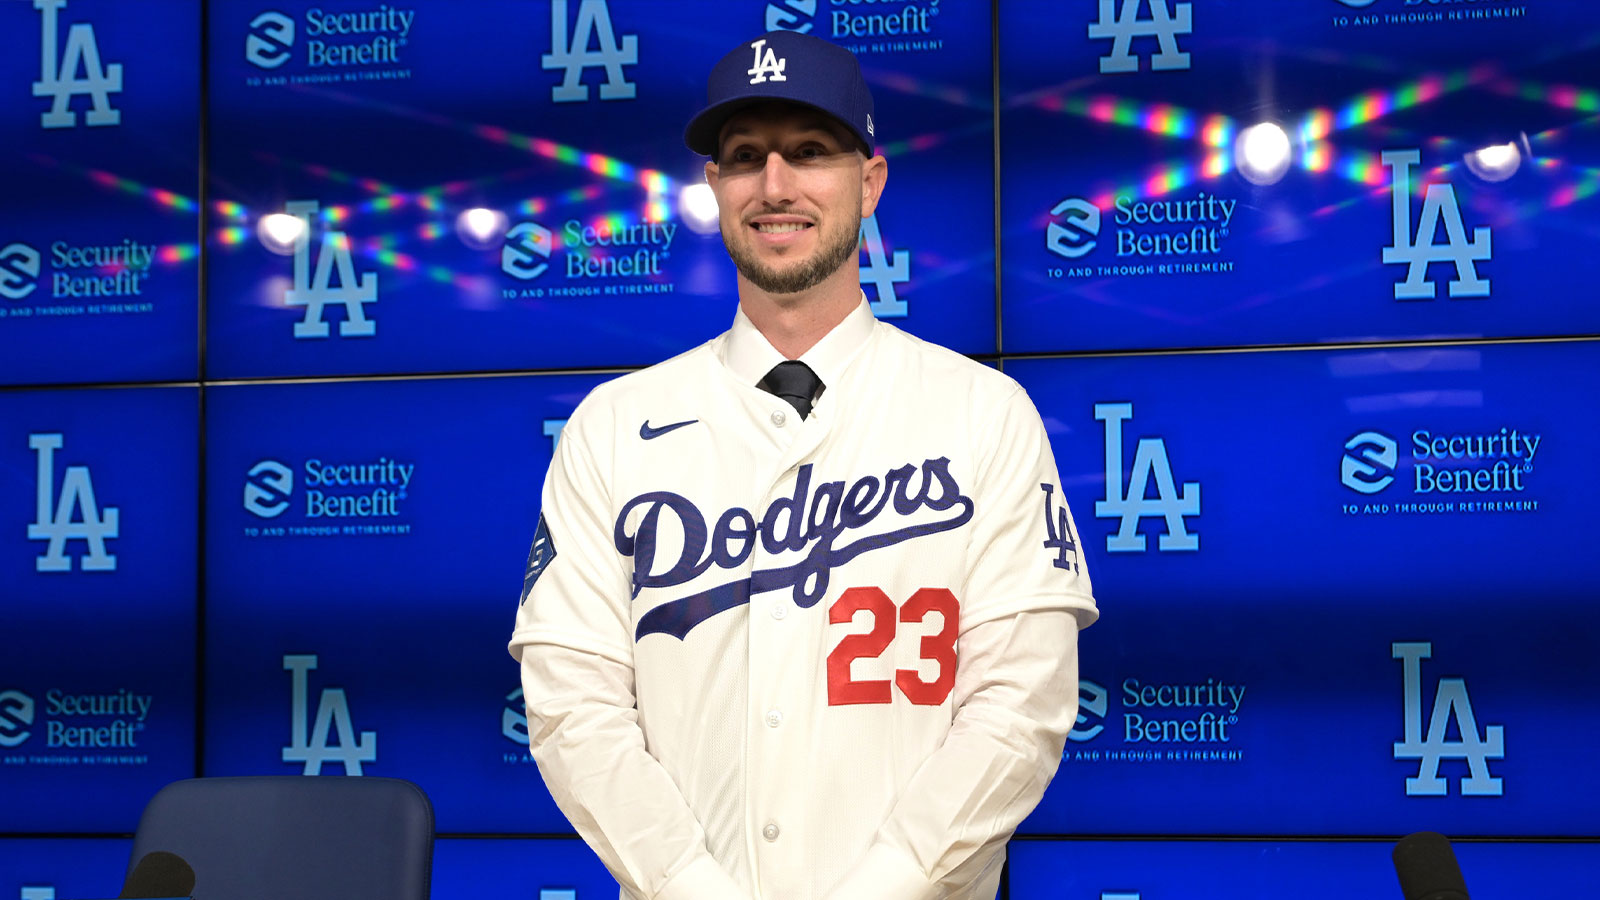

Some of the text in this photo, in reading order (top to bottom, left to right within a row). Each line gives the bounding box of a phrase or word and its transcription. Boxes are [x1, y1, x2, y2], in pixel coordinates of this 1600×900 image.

[306, 4, 414, 37] Security
[1333, 6, 1526, 27] TO AND THROUGH RETIREMENT
[32, 0, 123, 128] LA
[748, 39, 786, 85] LA
[1115, 192, 1237, 227] Security
[1381, 149, 1491, 299] LA
[564, 217, 677, 250] Security
[51, 238, 157, 271] Security
[285, 201, 378, 338] LA
[1048, 262, 1234, 278] TO AND THROUGH RETIREMENT
[503, 284, 674, 299] TO AND THROUGH RETIREMENT
[1412, 427, 1540, 462] Security
[305, 457, 414, 489] Security
[1094, 402, 1201, 552] LA
[27, 433, 119, 571] LA
[1343, 501, 1539, 514] TO AND THROUGH RETIREMENT
[614, 456, 973, 612] Dodgers
[1040, 483, 1079, 576] LA
[827, 586, 960, 706] 23
[46, 688, 152, 721] Security
[1122, 678, 1246, 714] Security
[282, 654, 376, 776] LA
[1391, 641, 1504, 796] LA
[1075, 750, 1099, 761] AND
[1105, 750, 1162, 762] THROUGH
[1167, 750, 1243, 761] RETIREMENT
